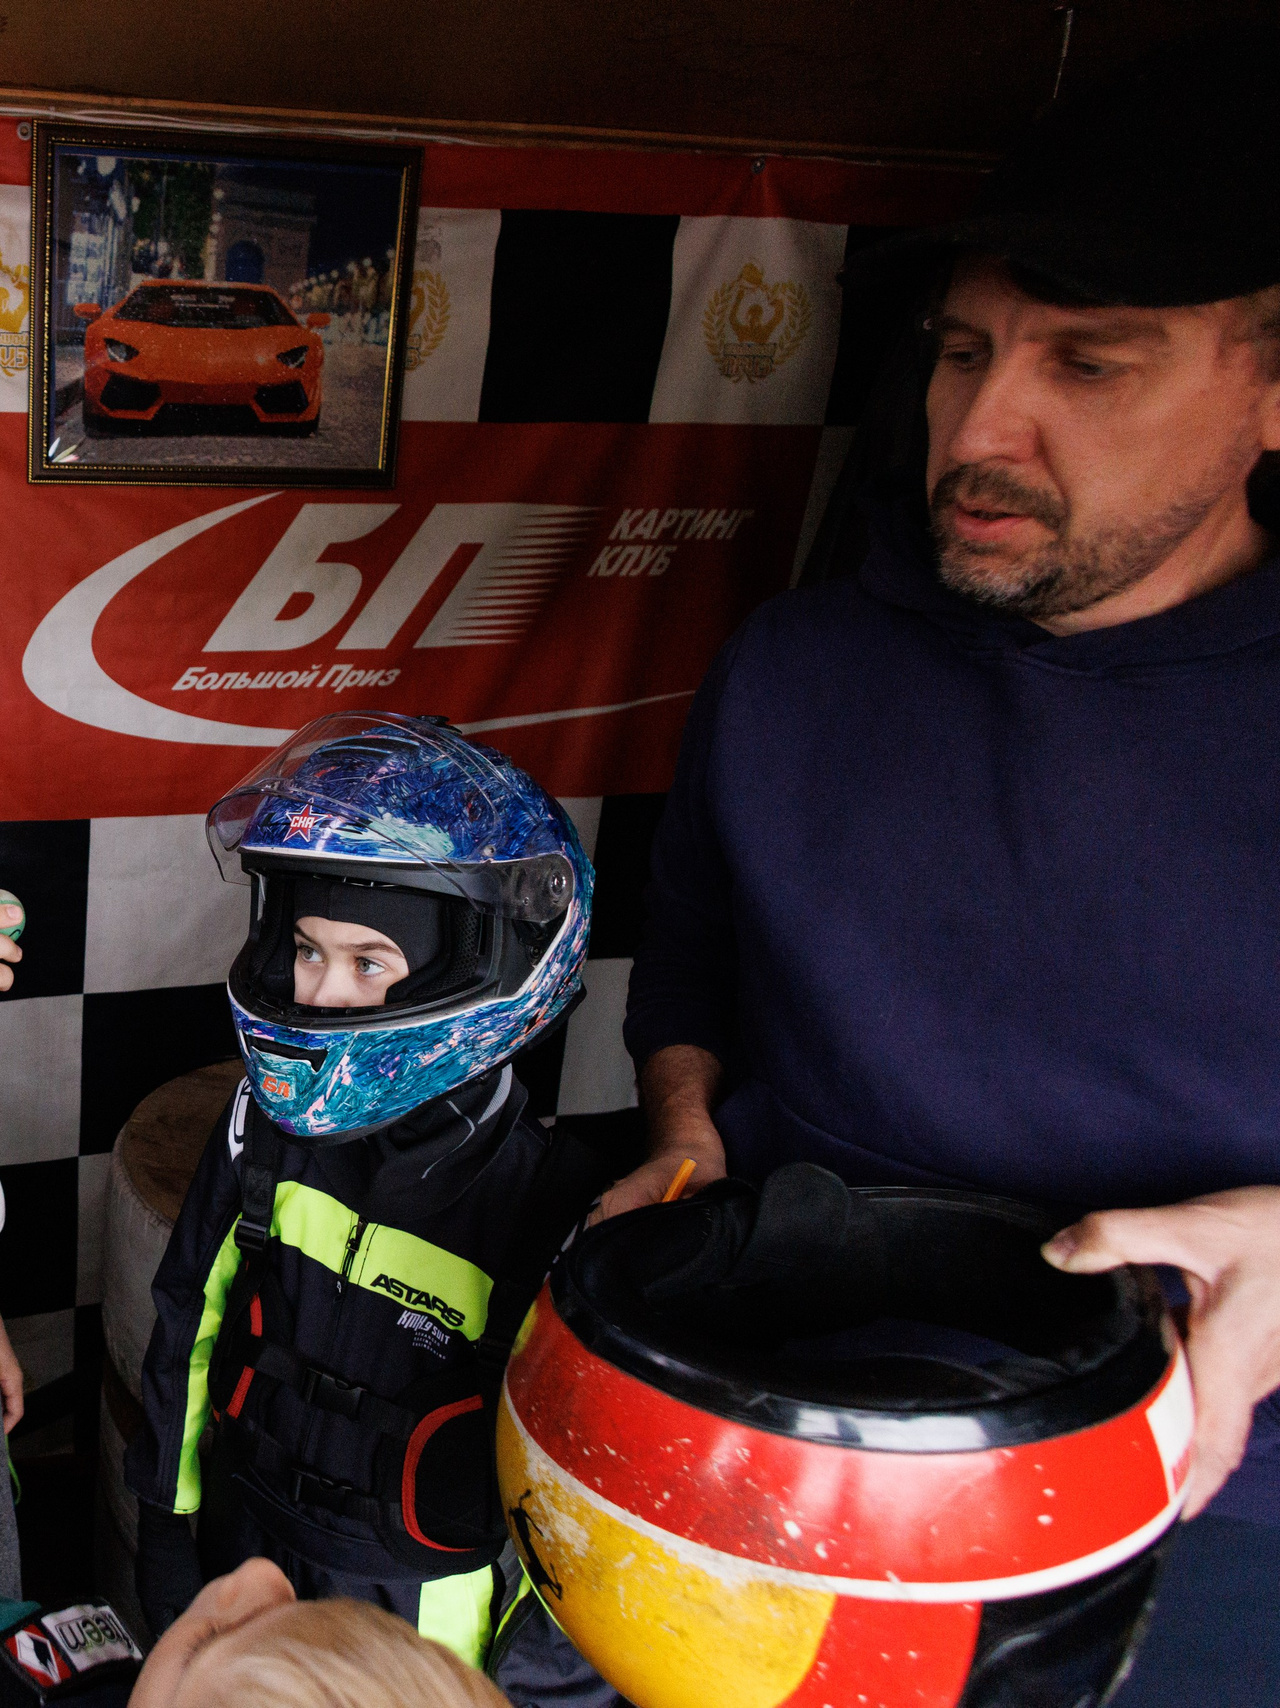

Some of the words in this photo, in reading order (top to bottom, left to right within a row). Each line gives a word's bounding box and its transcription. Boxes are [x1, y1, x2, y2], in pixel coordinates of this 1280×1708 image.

[609, 508, 755, 540] КАРТИНГ
[201, 502, 605, 652] БП
[586, 545, 677, 577] КЛУБ
[172, 664, 322, 691] Большой
[317, 663, 401, 693] Приз
[370, 1273, 466, 1327] ASTARS
[431, 1325, 451, 1345] SUIT
